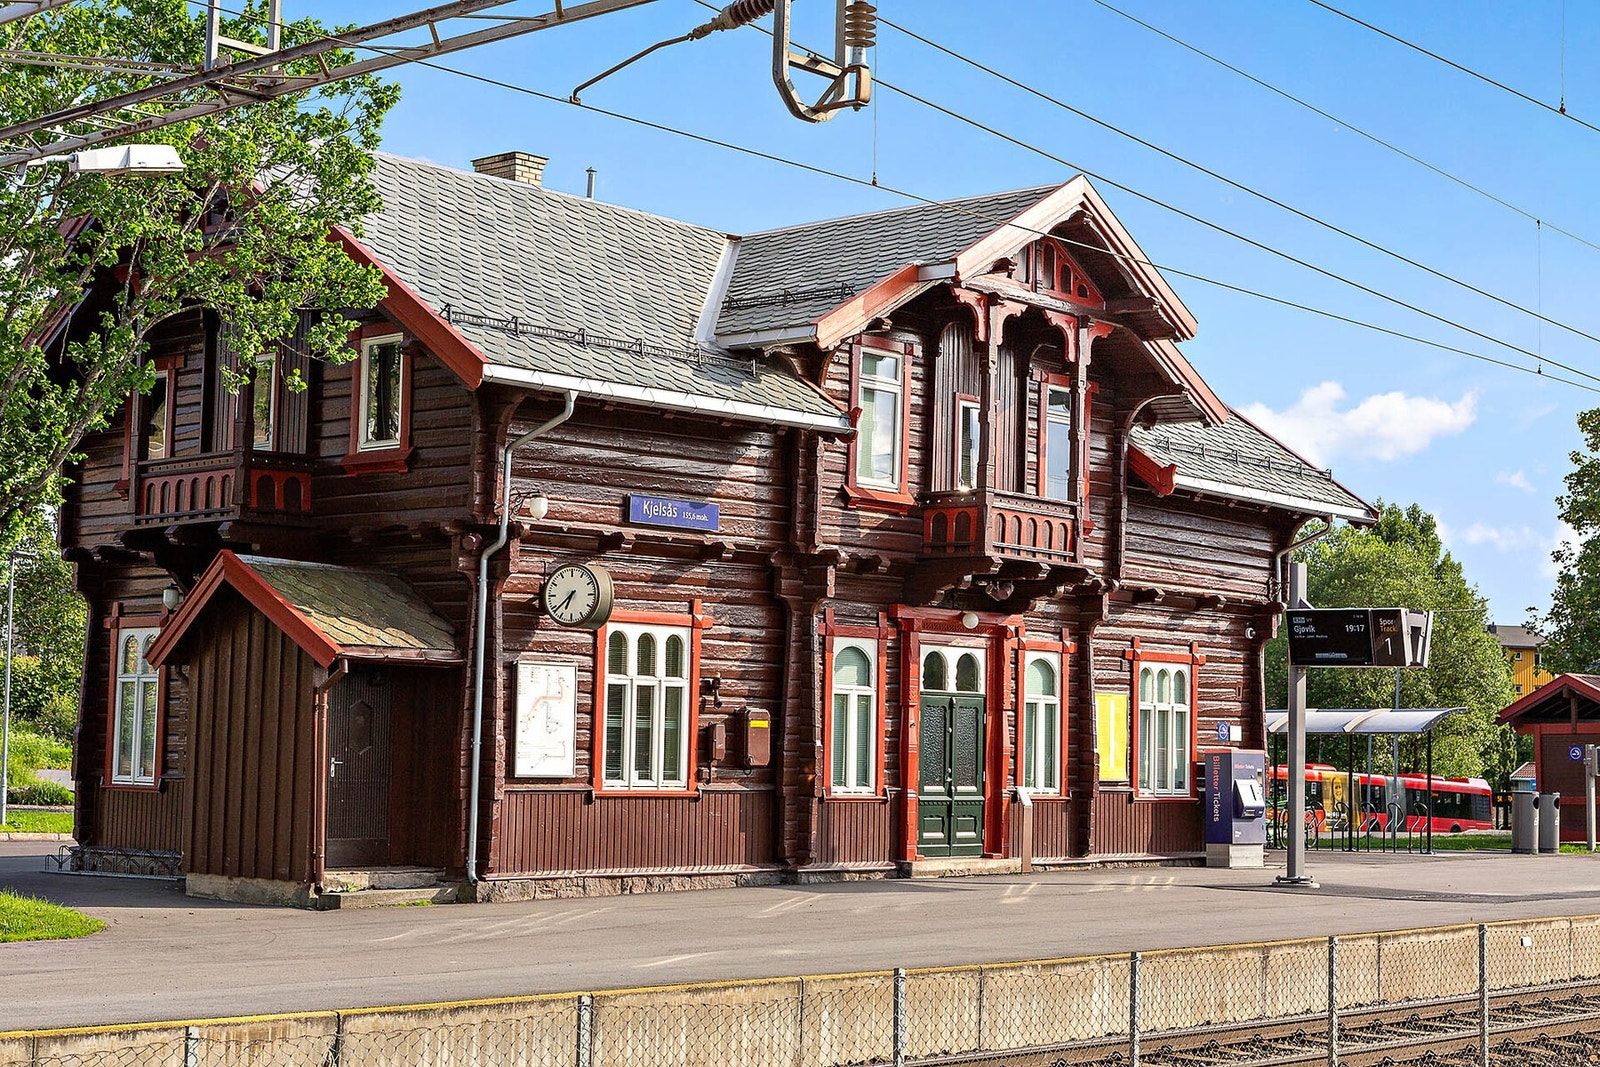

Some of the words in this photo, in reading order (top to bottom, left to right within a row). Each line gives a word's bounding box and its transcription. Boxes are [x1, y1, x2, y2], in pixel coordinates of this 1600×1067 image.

[643, 500, 678, 518] Kjelsås
[1345, 624, 1365, 632] 19:17
[1379, 618, 1394, 626] Spor
[1385, 637, 1392, 656] 1
[1213, 792, 1221, 822] Tickets
